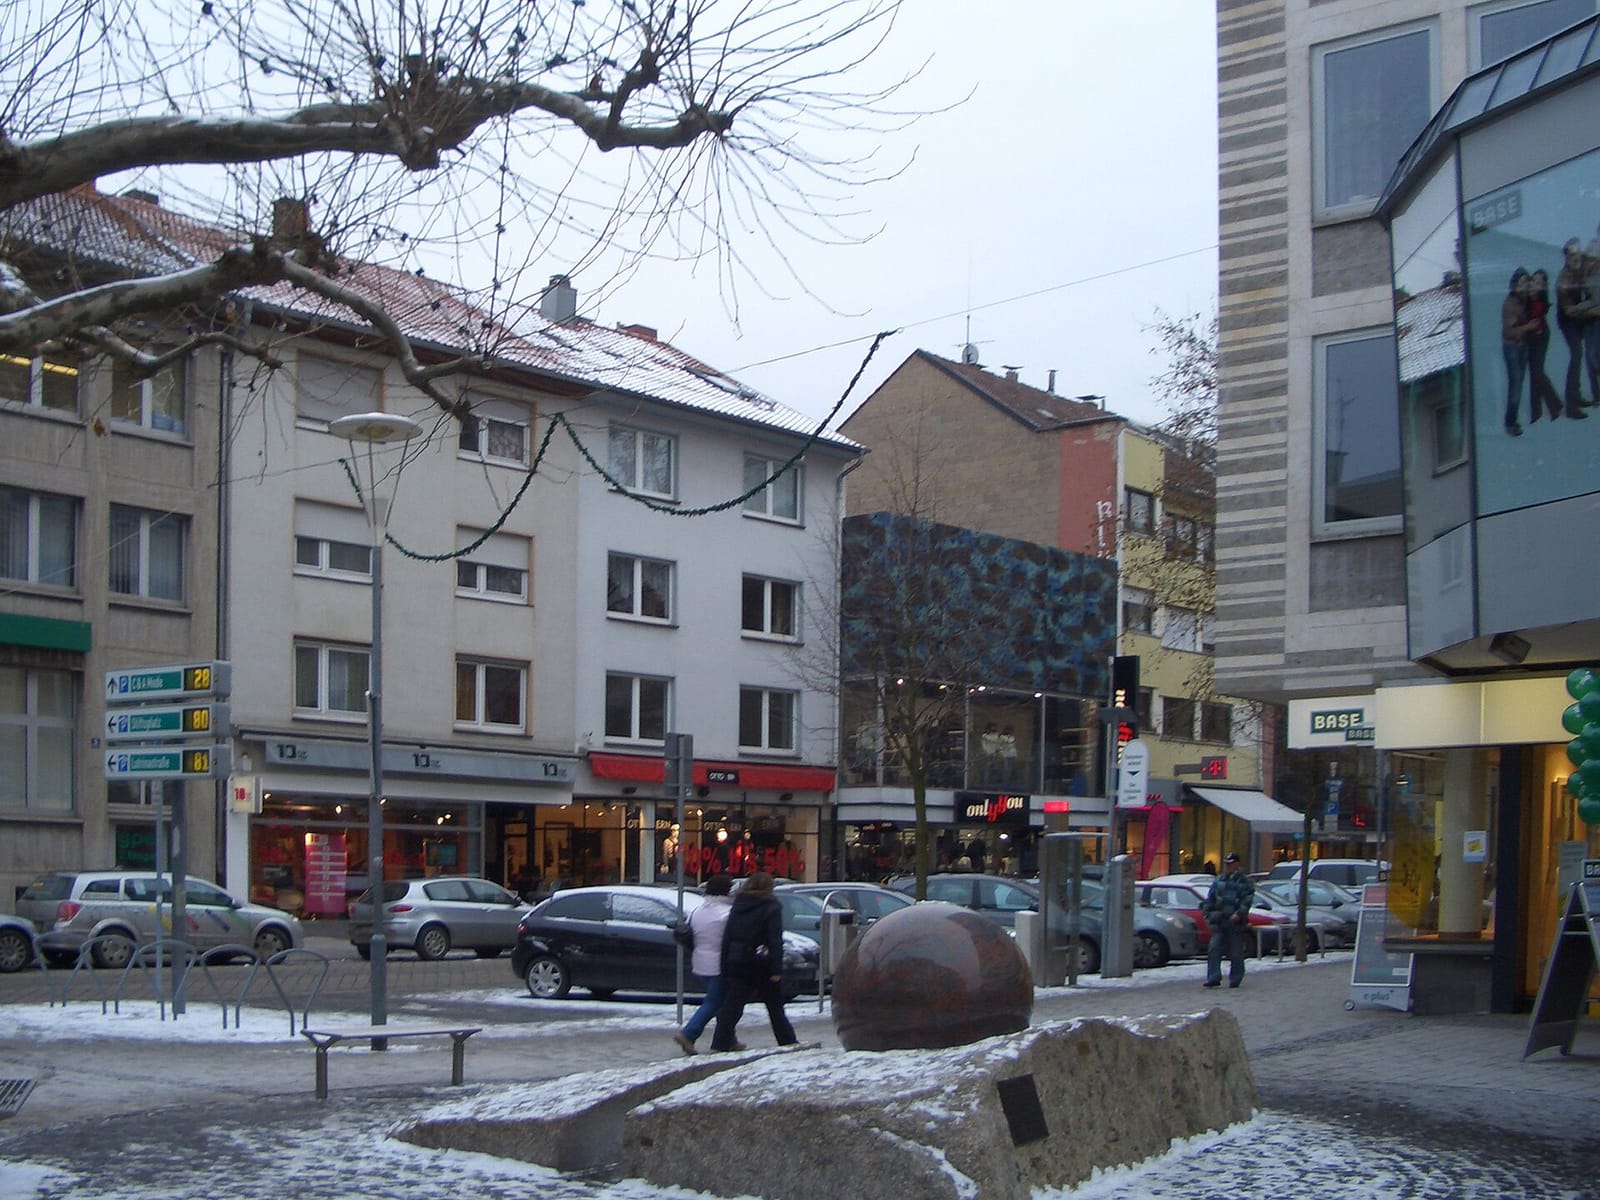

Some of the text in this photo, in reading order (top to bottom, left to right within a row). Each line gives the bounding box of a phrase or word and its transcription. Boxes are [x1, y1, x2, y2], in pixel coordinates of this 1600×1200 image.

[194, 668, 210, 689] 28
[193, 709, 209, 730] 80
[1314, 713, 1361, 729] BASE
[193, 752, 209, 772] 81
